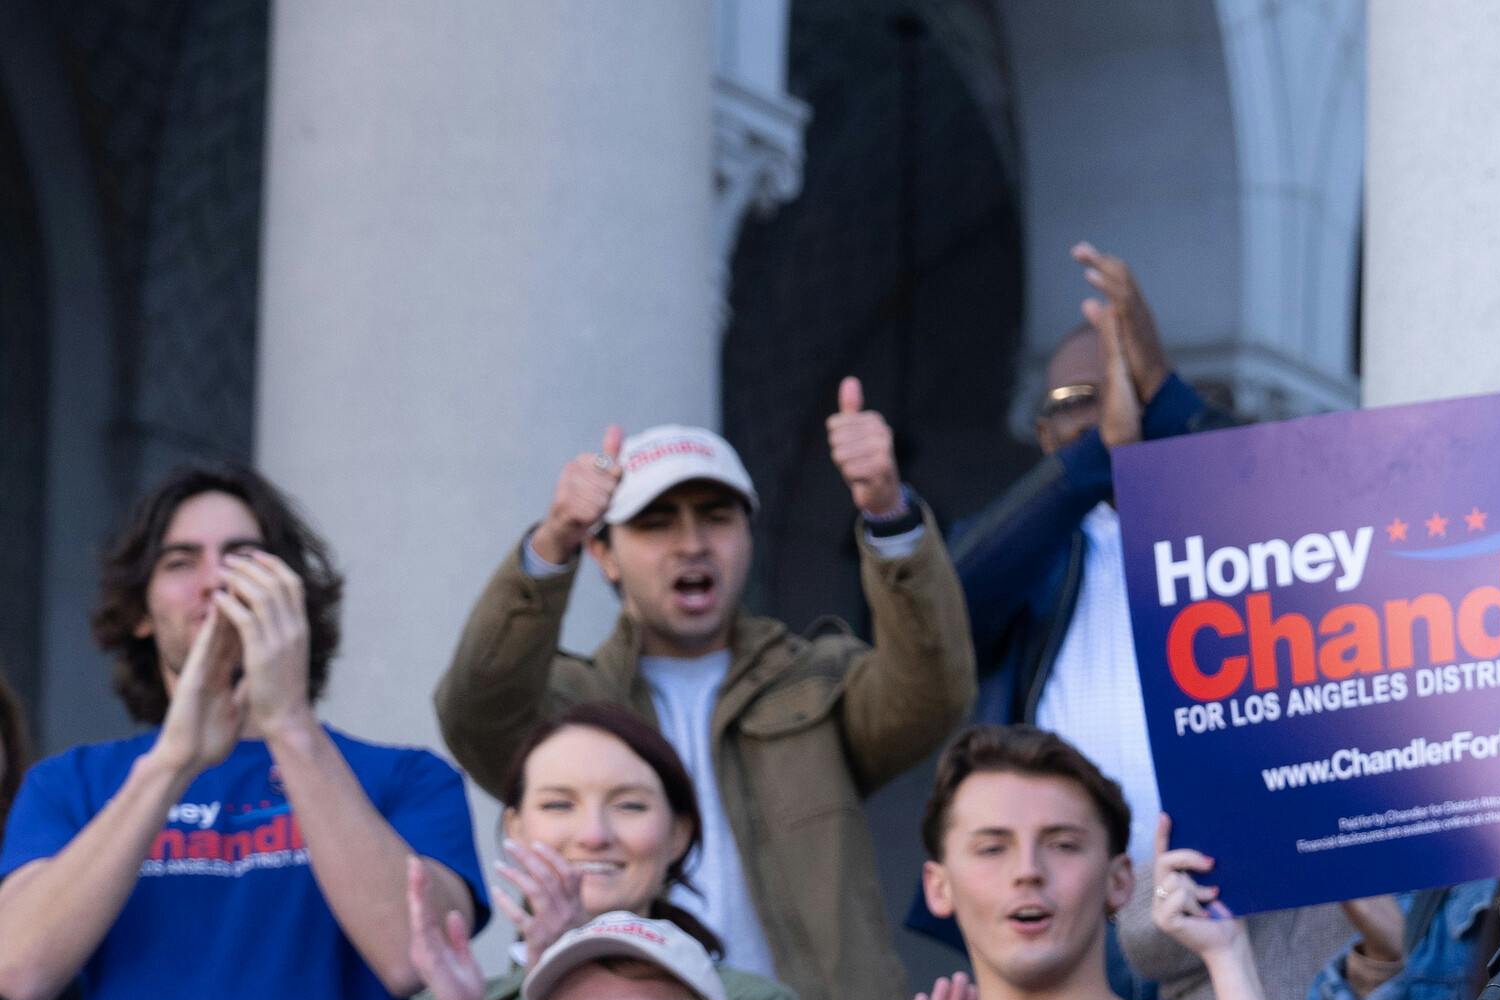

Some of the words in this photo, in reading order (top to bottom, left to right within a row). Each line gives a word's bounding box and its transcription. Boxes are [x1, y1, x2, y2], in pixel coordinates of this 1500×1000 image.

[1153, 526, 1375, 606] Honey
[1174, 703, 1226, 736] FOR
[1230, 691, 1281, 728] LOS
[1287, 671, 1408, 717] ANGELES
